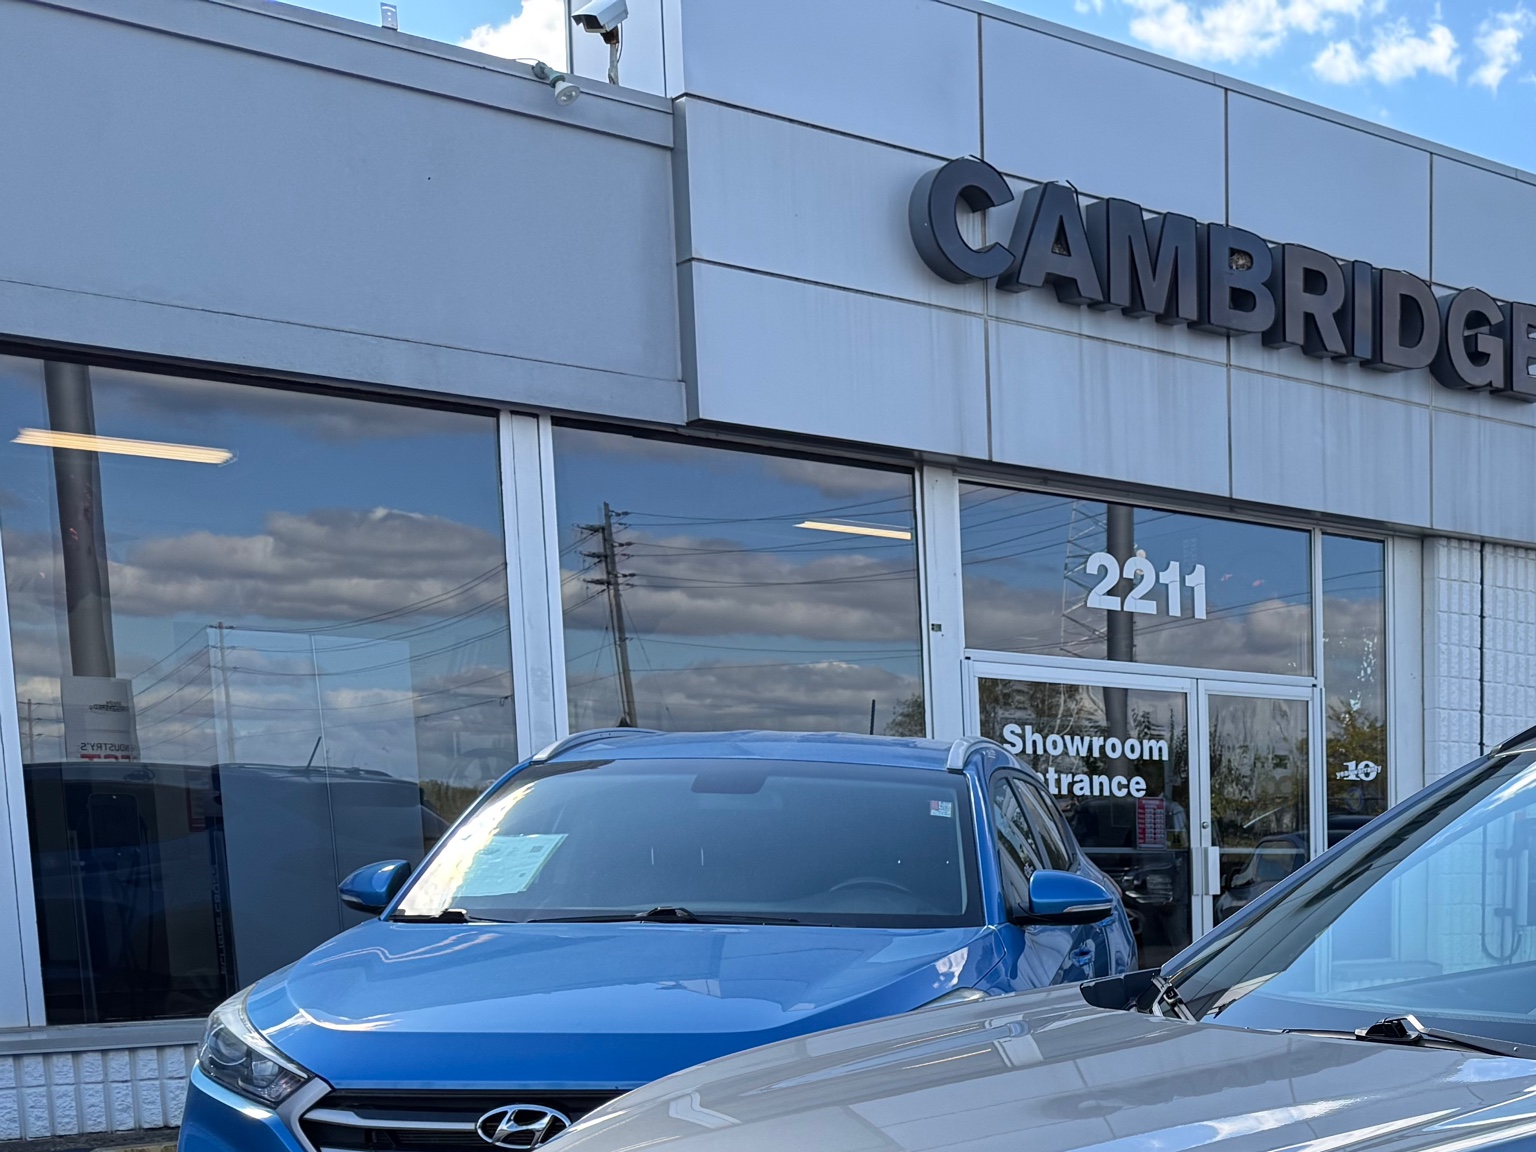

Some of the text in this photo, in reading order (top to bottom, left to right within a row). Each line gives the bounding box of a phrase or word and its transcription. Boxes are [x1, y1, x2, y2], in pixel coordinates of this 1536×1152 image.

[1086, 551, 1207, 620] 2211
[1002, 724, 1169, 761] Showroom
[1036, 766, 1147, 798] trance
